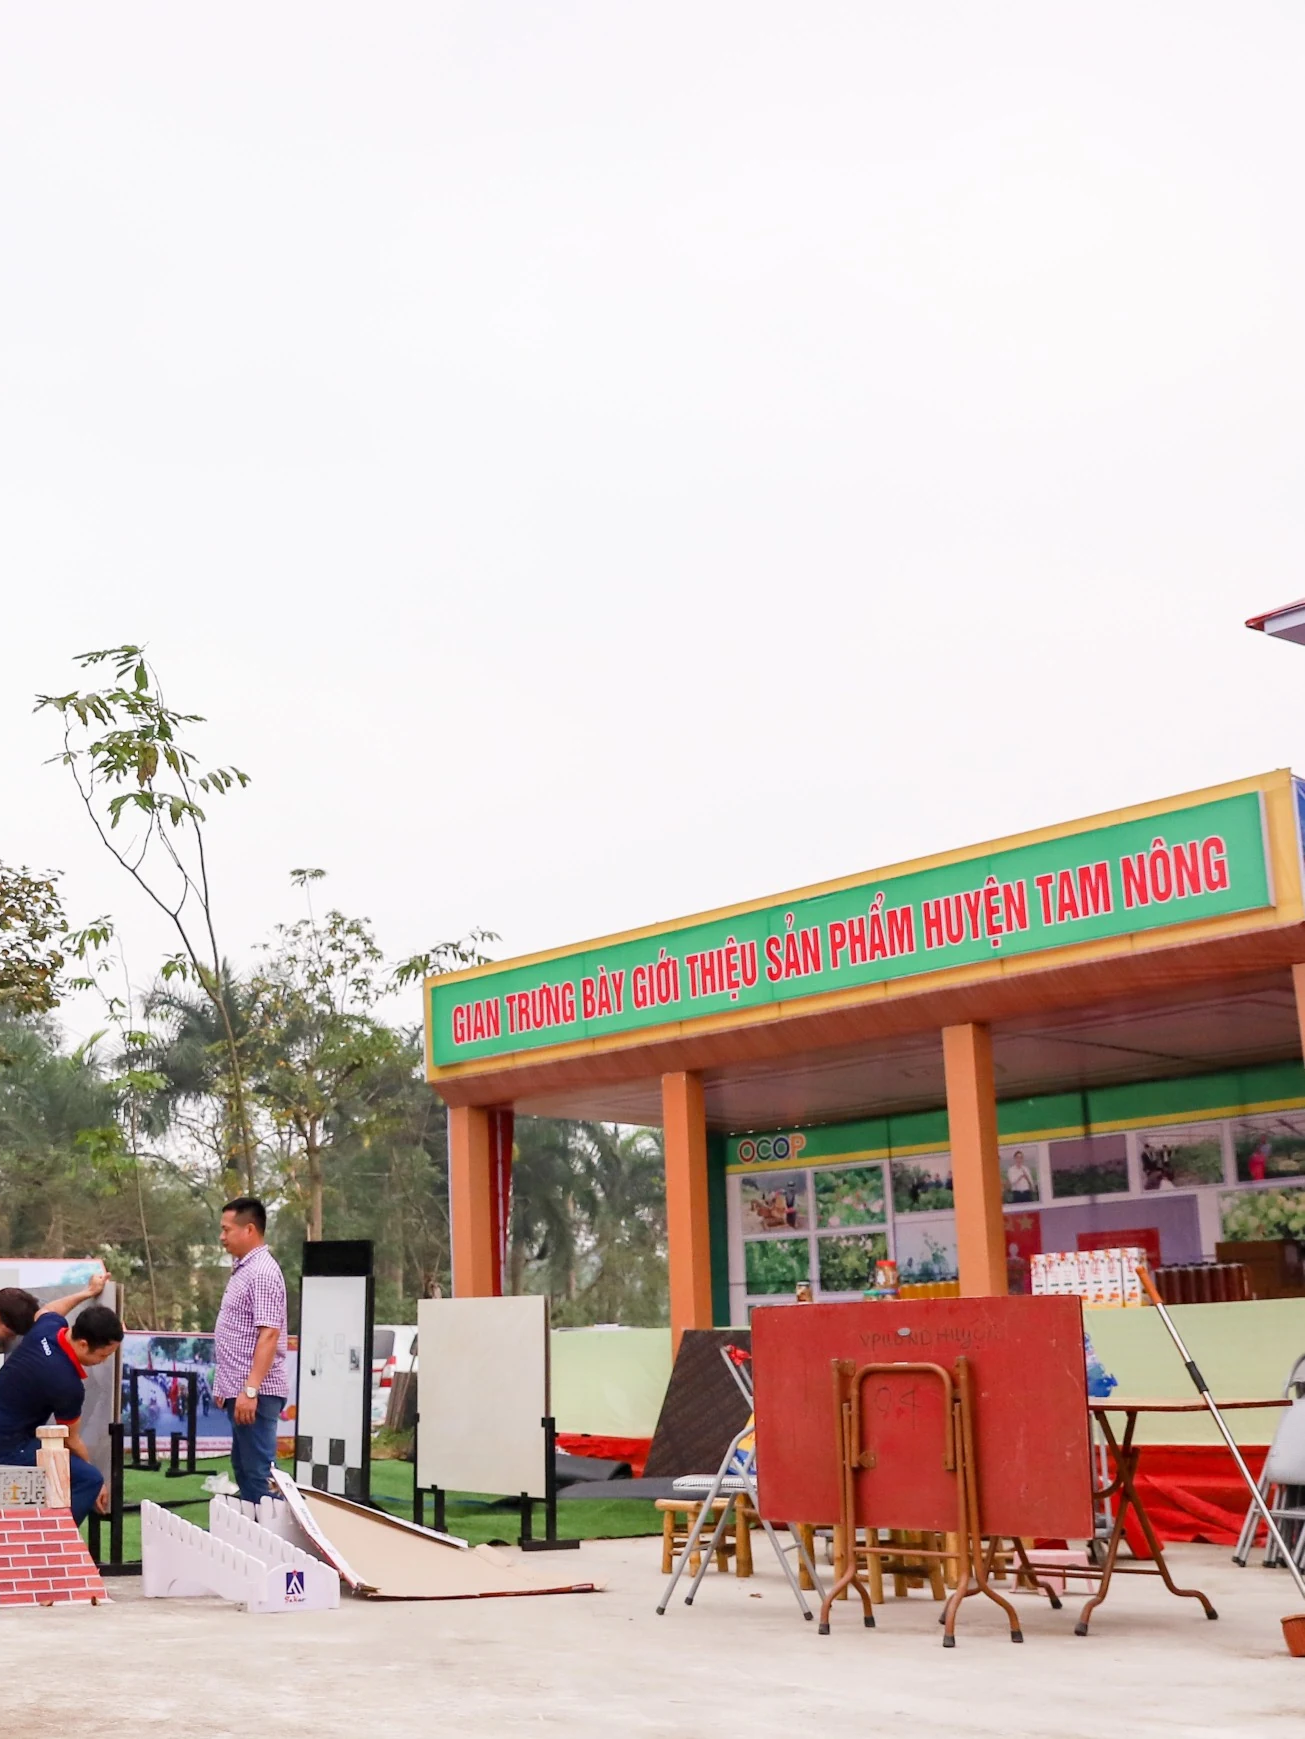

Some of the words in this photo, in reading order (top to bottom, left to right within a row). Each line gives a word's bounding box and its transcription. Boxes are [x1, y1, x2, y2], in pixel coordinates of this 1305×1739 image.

[453, 998, 500, 1044] GIAN
[505, 982, 575, 1033] TRƯNG
[581, 965, 624, 1019] BÀY
[631, 946, 680, 1009] GIỚI
[686, 933, 758, 1000] THIỆU
[766, 912, 823, 982] SẢN
[828, 892, 915, 969] PHẨM
[921, 876, 1028, 948] HUYỆN
[1035, 850, 1113, 926] TAM
[1120, 836, 1230, 909] NÔNG
[738, 1132, 806, 1165] OCOP
